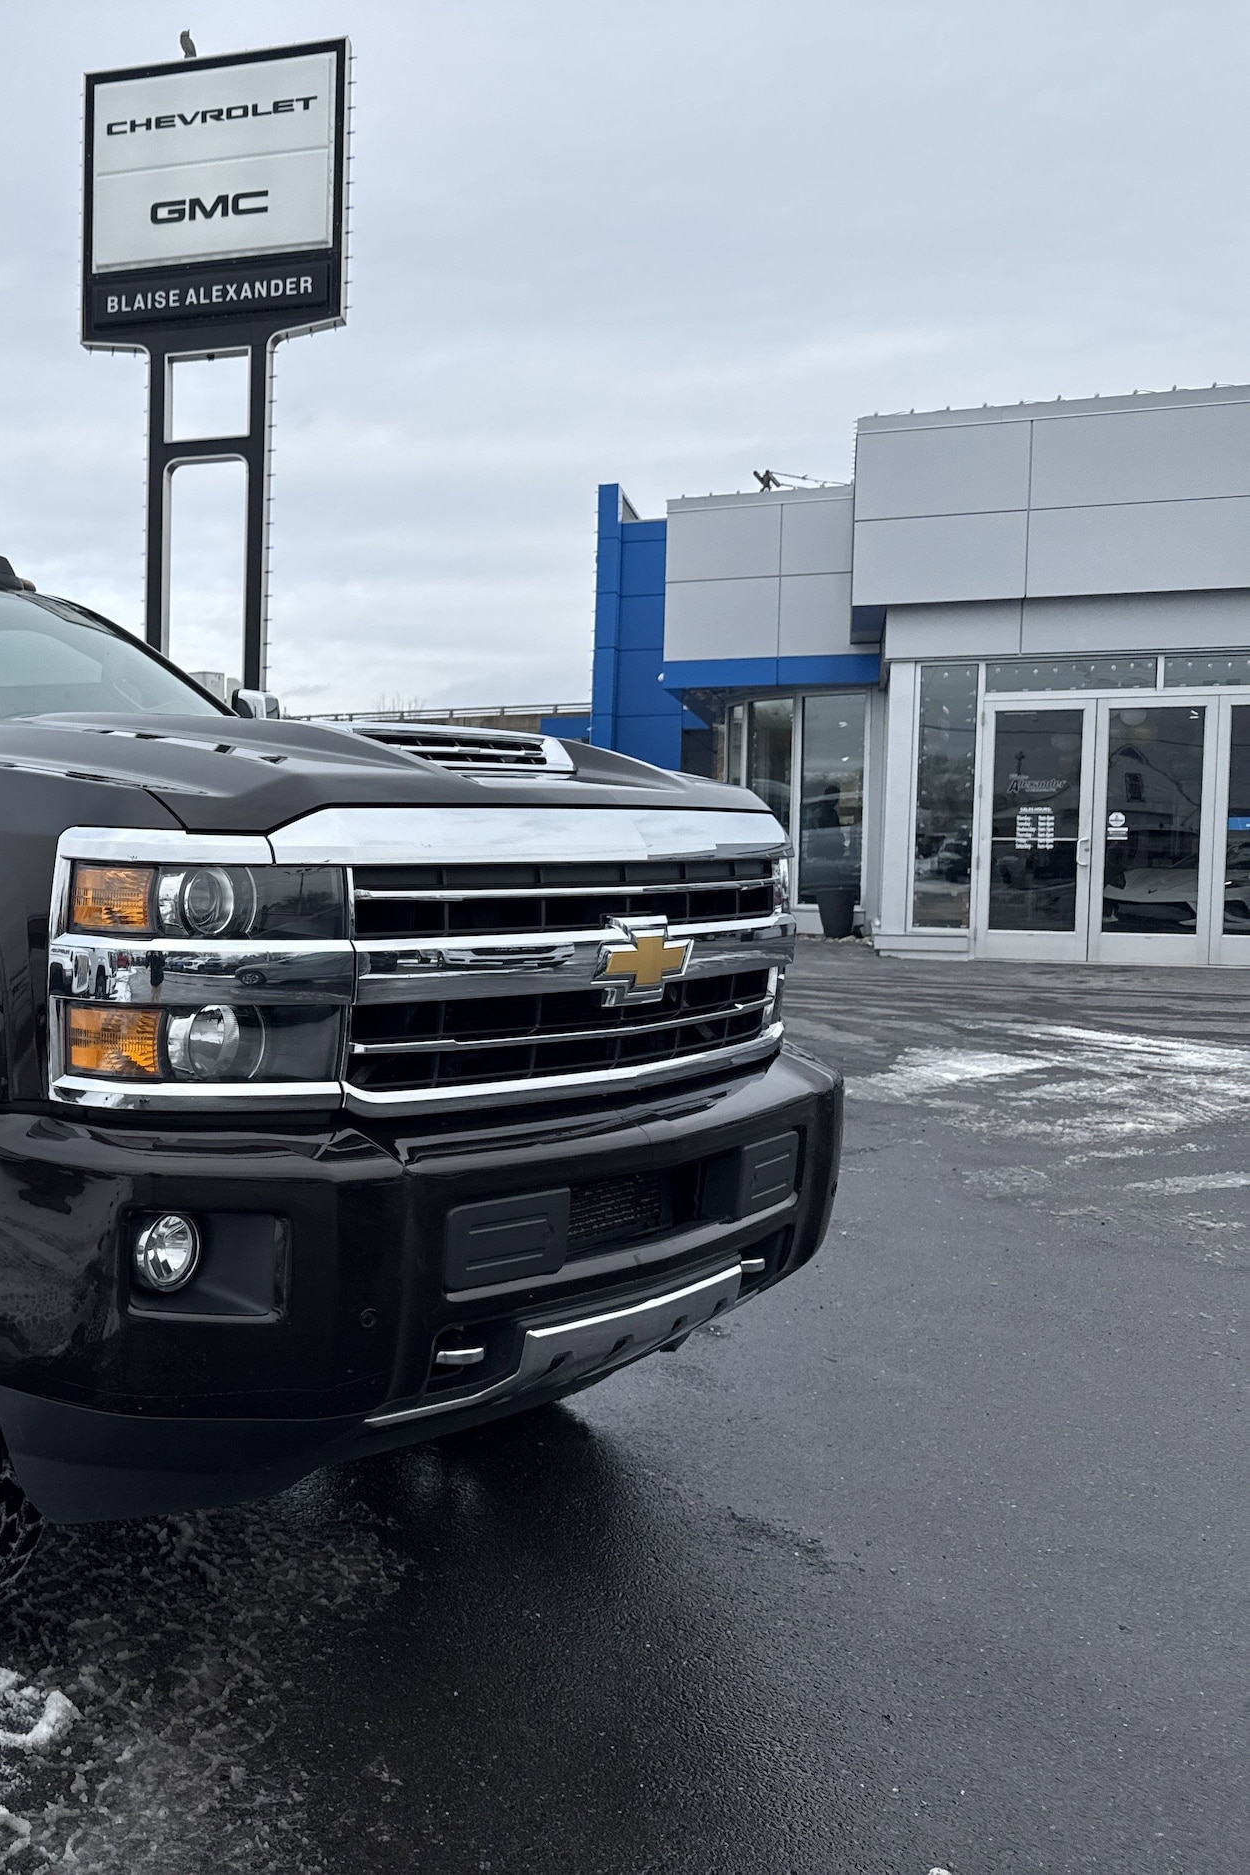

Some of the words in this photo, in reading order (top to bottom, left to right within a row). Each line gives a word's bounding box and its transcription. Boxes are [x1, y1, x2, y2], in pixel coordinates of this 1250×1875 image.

[106, 95, 318, 136] CHEVROLET
[150, 189, 269, 225] GMC
[106, 288, 181, 314] BLAISE
[185, 276, 313, 306] ALEXANDER
